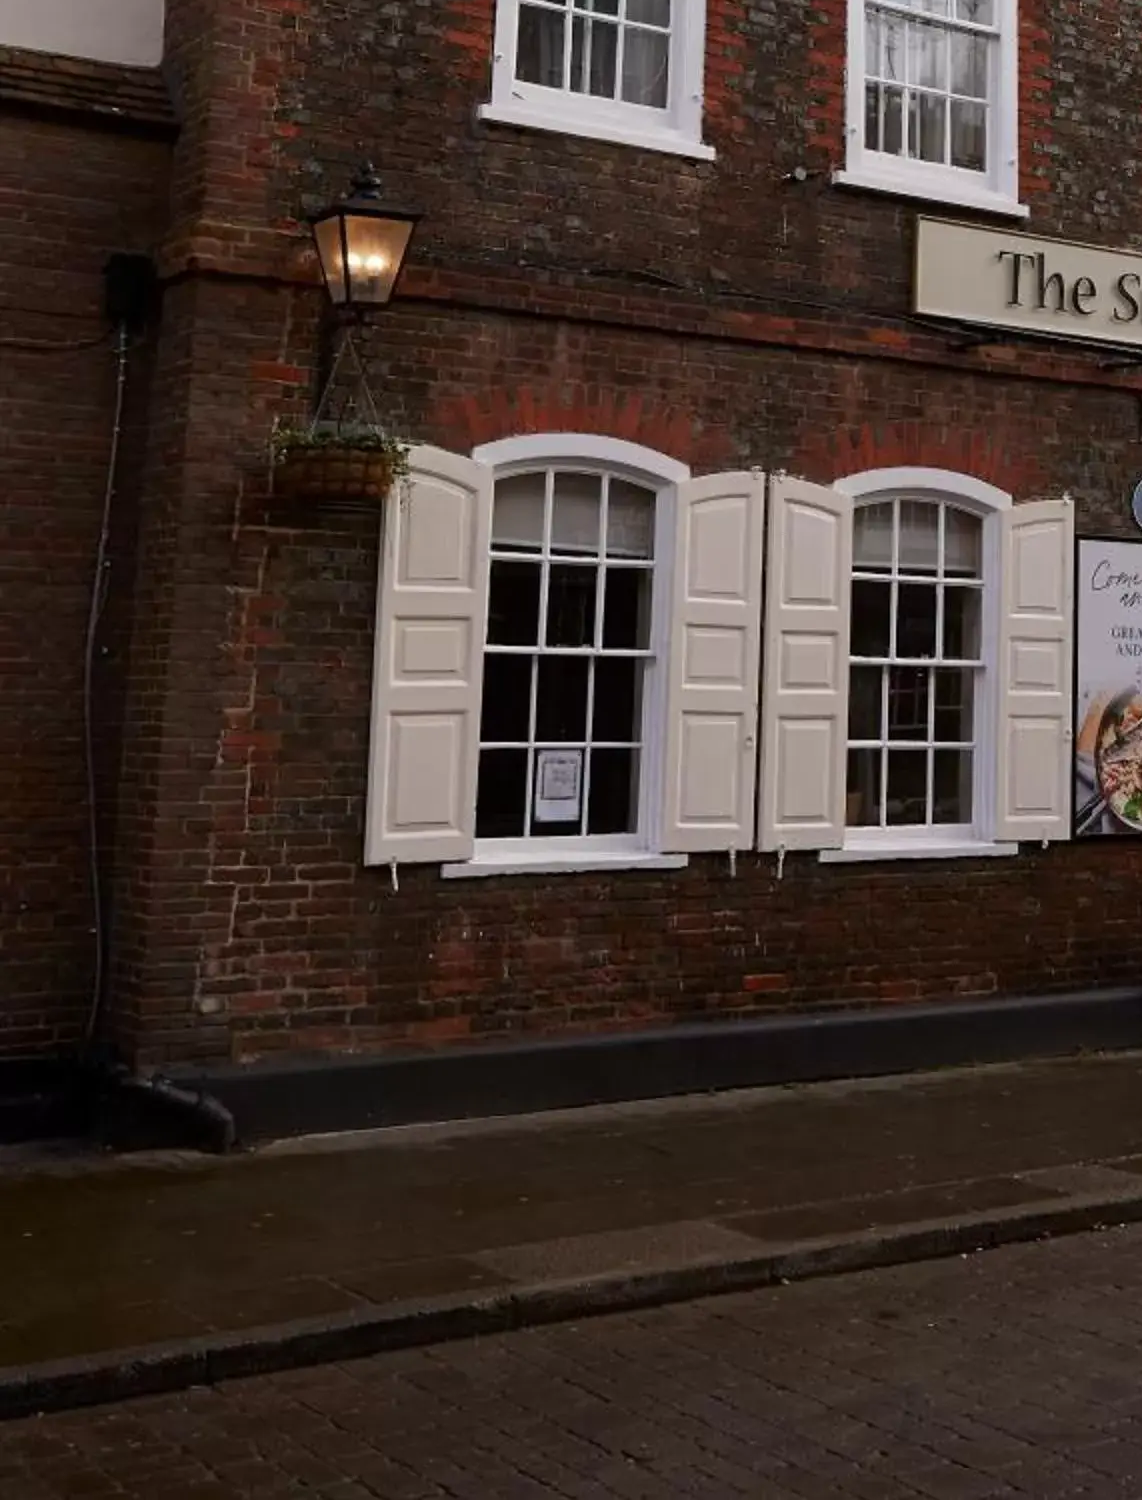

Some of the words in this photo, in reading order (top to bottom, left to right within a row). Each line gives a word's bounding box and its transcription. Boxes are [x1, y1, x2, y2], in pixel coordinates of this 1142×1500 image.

[998, 251, 1097, 316] The
[1092, 559, 1142, 591] Come
[1116, 643, 1142, 657] AND
